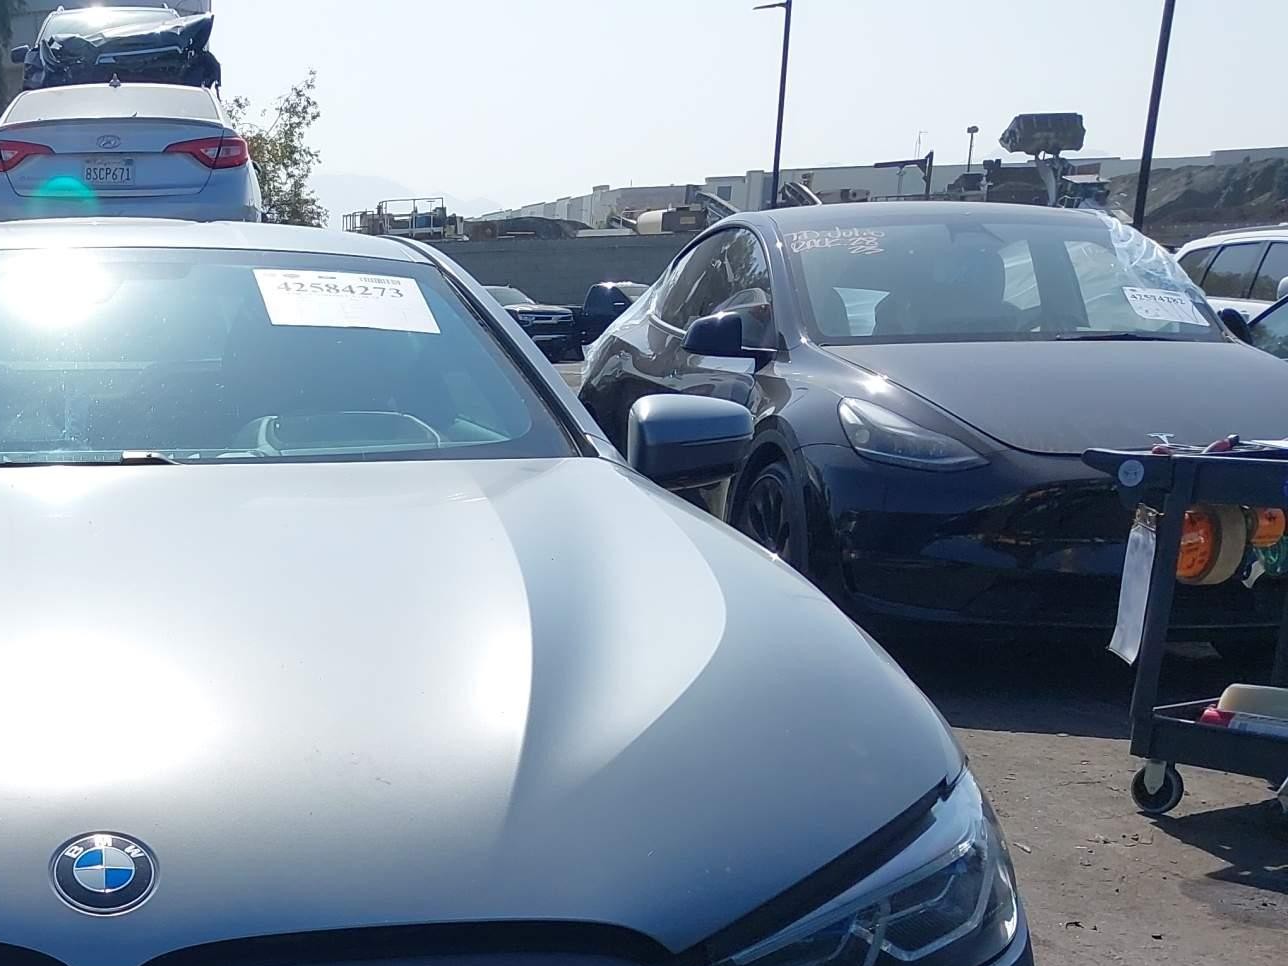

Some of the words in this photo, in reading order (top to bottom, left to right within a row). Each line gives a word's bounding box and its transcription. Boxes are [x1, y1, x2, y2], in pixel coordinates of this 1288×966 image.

[85, 167, 131, 181] 8SCP671
[277, 281, 404, 298] 42584273
[64, 833, 145, 859] BMW
